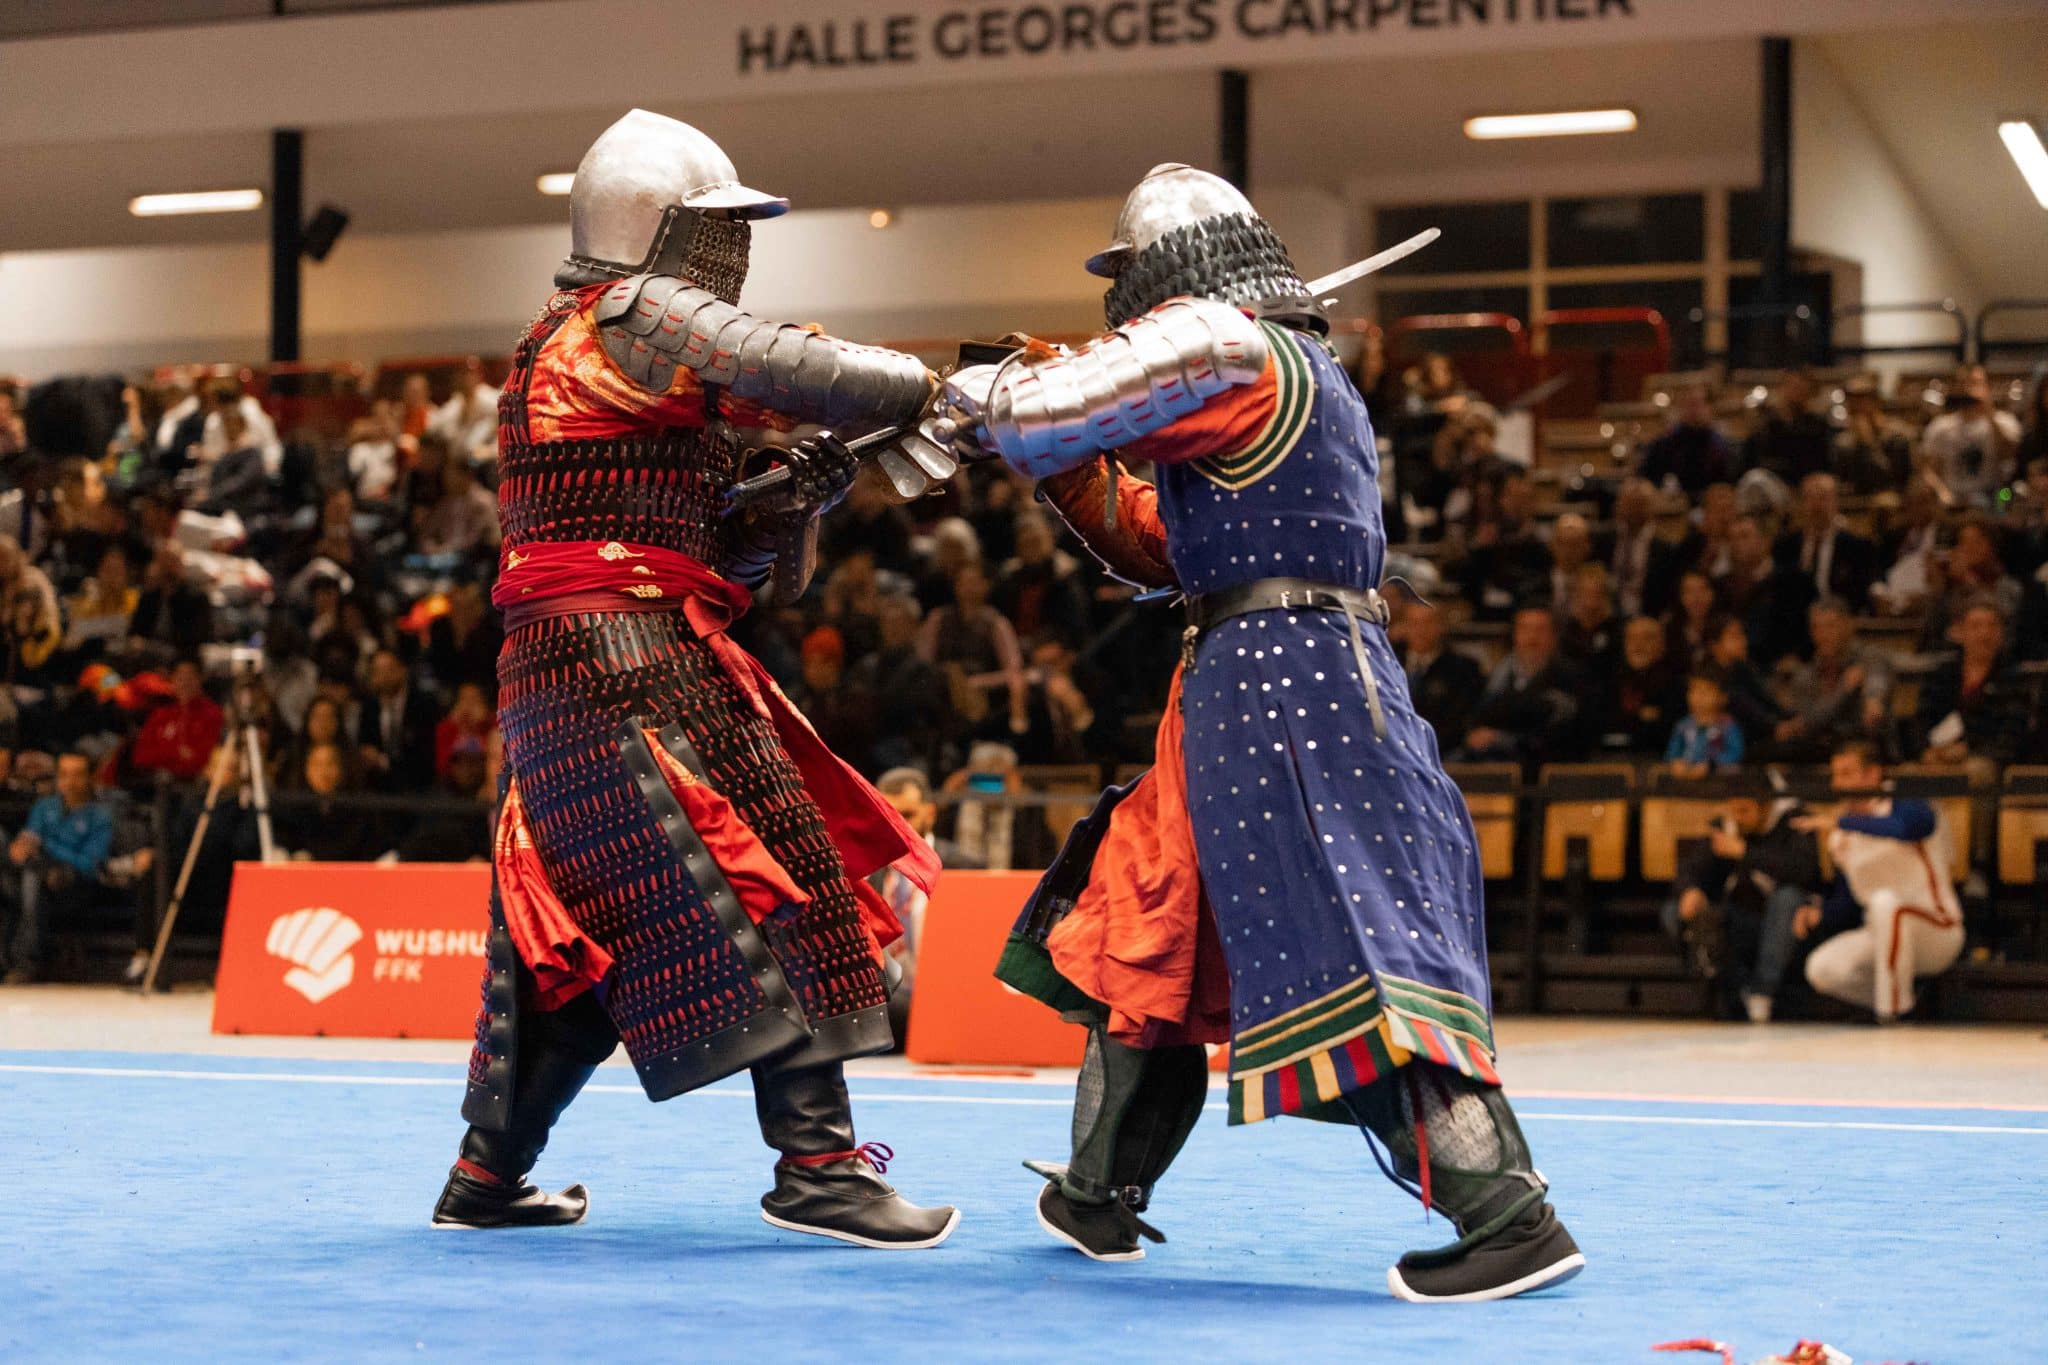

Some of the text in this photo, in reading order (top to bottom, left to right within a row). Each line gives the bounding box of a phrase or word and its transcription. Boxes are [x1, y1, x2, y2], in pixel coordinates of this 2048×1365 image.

[738, 15, 918, 72] HALLE
[932, 0, 1217, 58] GEORGES
[374, 929, 487, 957] WUSHU
[373, 958, 422, 981] FFK
